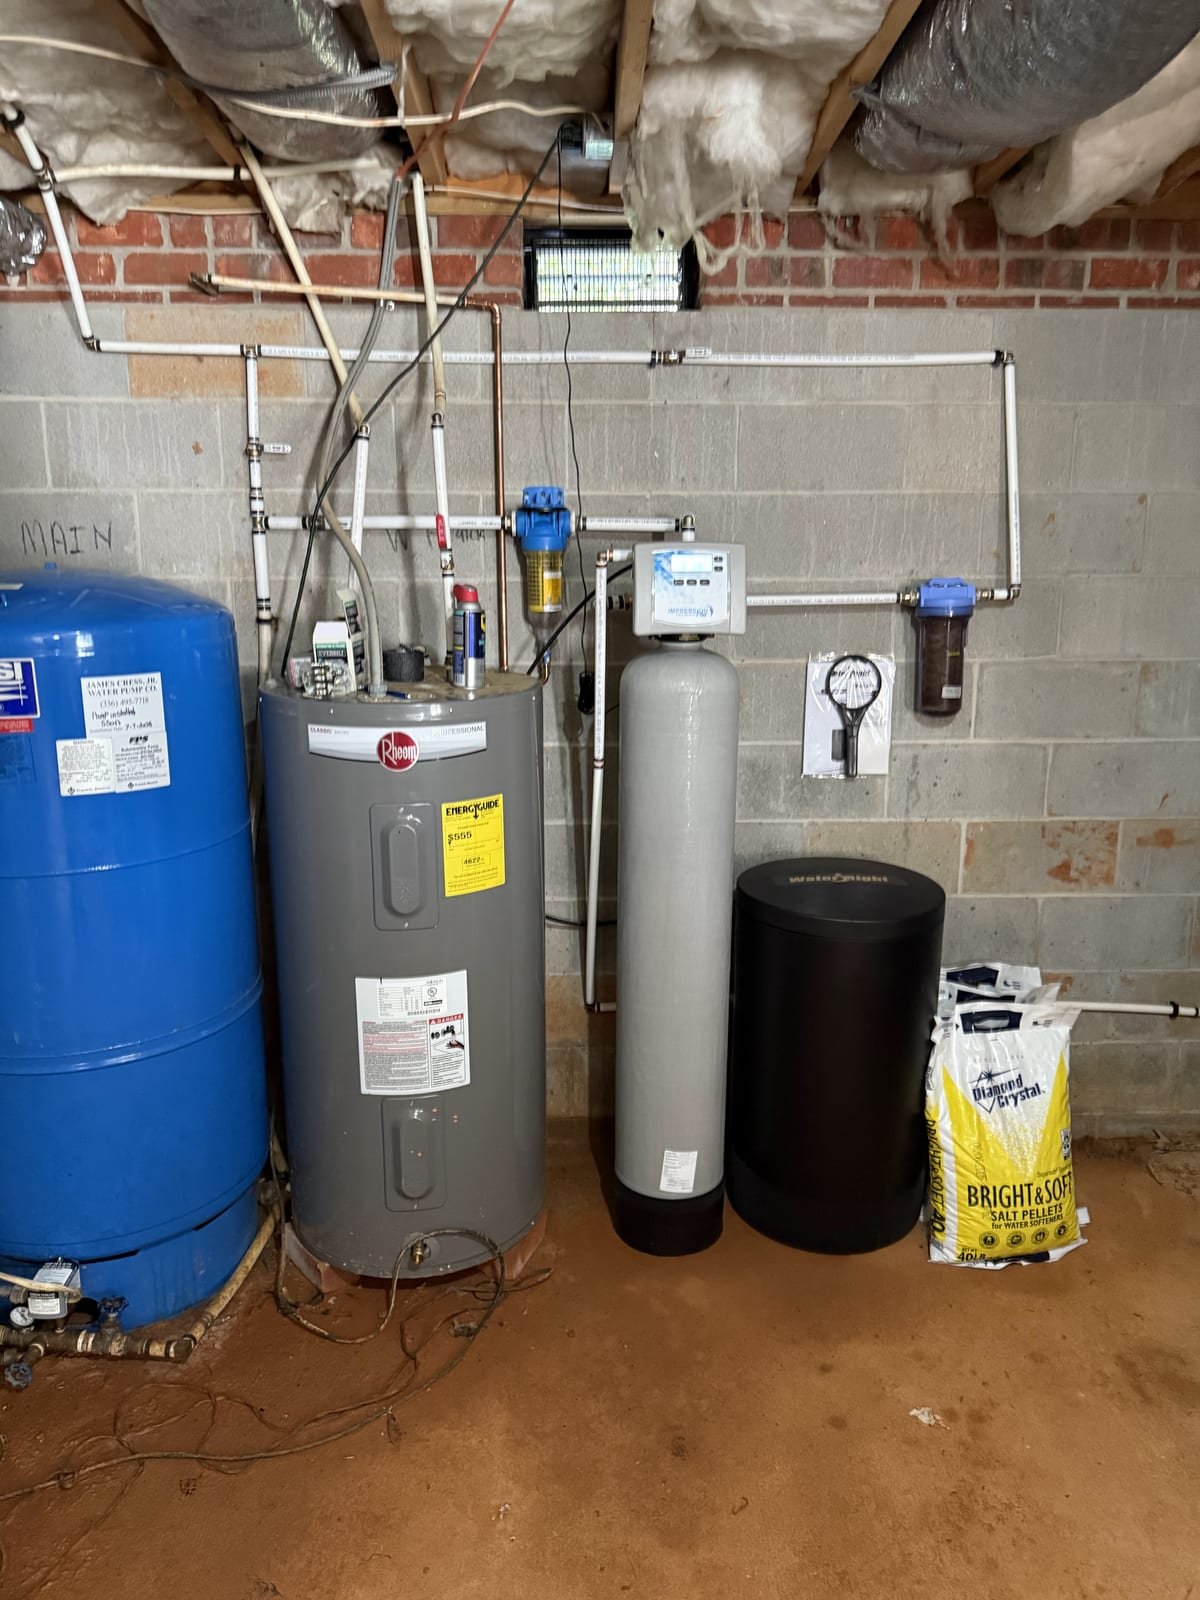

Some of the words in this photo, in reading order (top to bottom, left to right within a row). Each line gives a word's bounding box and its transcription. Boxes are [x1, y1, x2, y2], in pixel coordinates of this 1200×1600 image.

[21, 519, 112, 556] MAIN
[87, 680, 115, 689] JAMES
[88, 688, 118, 696] WATER
[120, 686, 144, 695] PUMP
[380, 732, 418, 765] Rheem
[447, 831, 472, 842] $555
[972, 1073, 1023, 1101] Diamond
[997, 1082, 1041, 1108] Crystal
[991, 1211, 1018, 1222] SALT
[1022, 1203, 1063, 1220] PELLETS
[992, 1222, 1003, 1230] for
[1004, 1220, 1029, 1229] WATER
[1030, 1214, 1064, 1227] SOFTENERS
